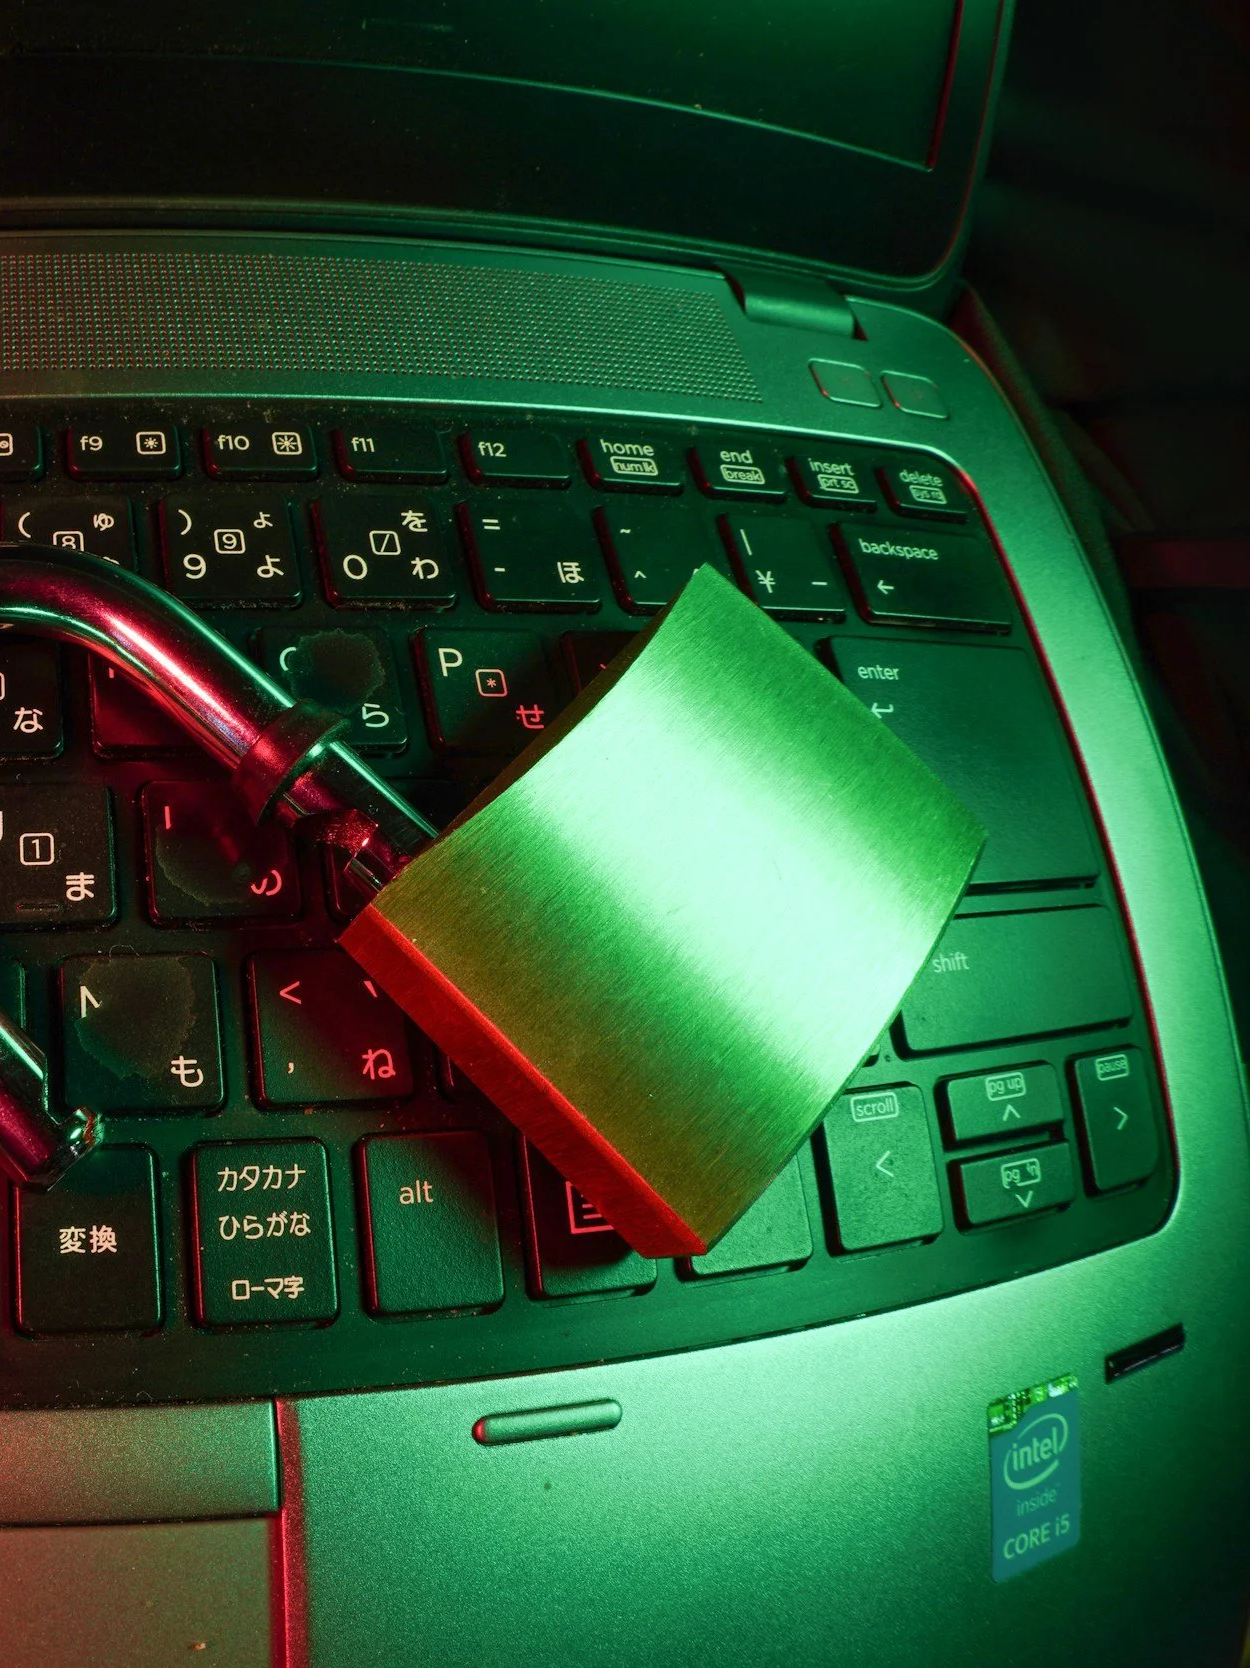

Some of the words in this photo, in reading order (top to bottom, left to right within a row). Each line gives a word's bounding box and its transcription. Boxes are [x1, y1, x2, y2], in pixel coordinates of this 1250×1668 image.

[80, 436, 103, 451] f9
[217, 435, 249, 450] f10
[351, 437, 374, 452] f11
[478, 442, 506, 457] f12
[600, 439, 654, 456] home
[720, 450, 753, 463] end
[808, 458, 854, 476] insert
[724, 470, 761, 482] break
[899, 470, 943, 486] delete
[18, 512, 31, 538] (
[178, 509, 192, 535] )
[401, 510, 428, 532] を
[482, 519, 500, 530] =
[858, 538, 938, 560] backspace
[183, 554, 206, 579] 9
[257, 555, 284, 578] よ
[411, 557, 439, 579] わ
[557, 562, 584, 583] ほ
[756, 570, 775, 593] ¥
[439, 648, 462, 676] P
[858, 665, 899, 680] enter
[13, 707, 43, 733] な
[516, 704, 544, 729] せ
[66, 872, 94, 901] ま
[932, 952, 969, 973] shift
[171, 1056, 203, 1087] も
[362, 1049, 396, 1080] ね
[1098, 1060, 1127, 1076] pause
[988, 1081, 1005, 1096] pg
[1007, 1077, 1023, 1091] up
[856, 1097, 895, 1117] scroll
[218, 1164, 306, 1191] カタカナ
[1004, 1168, 1020, 1183] pg
[400, 1180, 433, 1204] alt
[219, 1211, 311, 1240] ひらがな
[59, 1225, 117, 1253] 変換
[232, 1276, 304, 1300] ローマ字
[1012, 1426, 1058, 1472] intel
[1016, 1489, 1056, 1516] inside
[1003, 1522, 1050, 1559] CORE
[1054, 1513, 1070, 1537] i5
